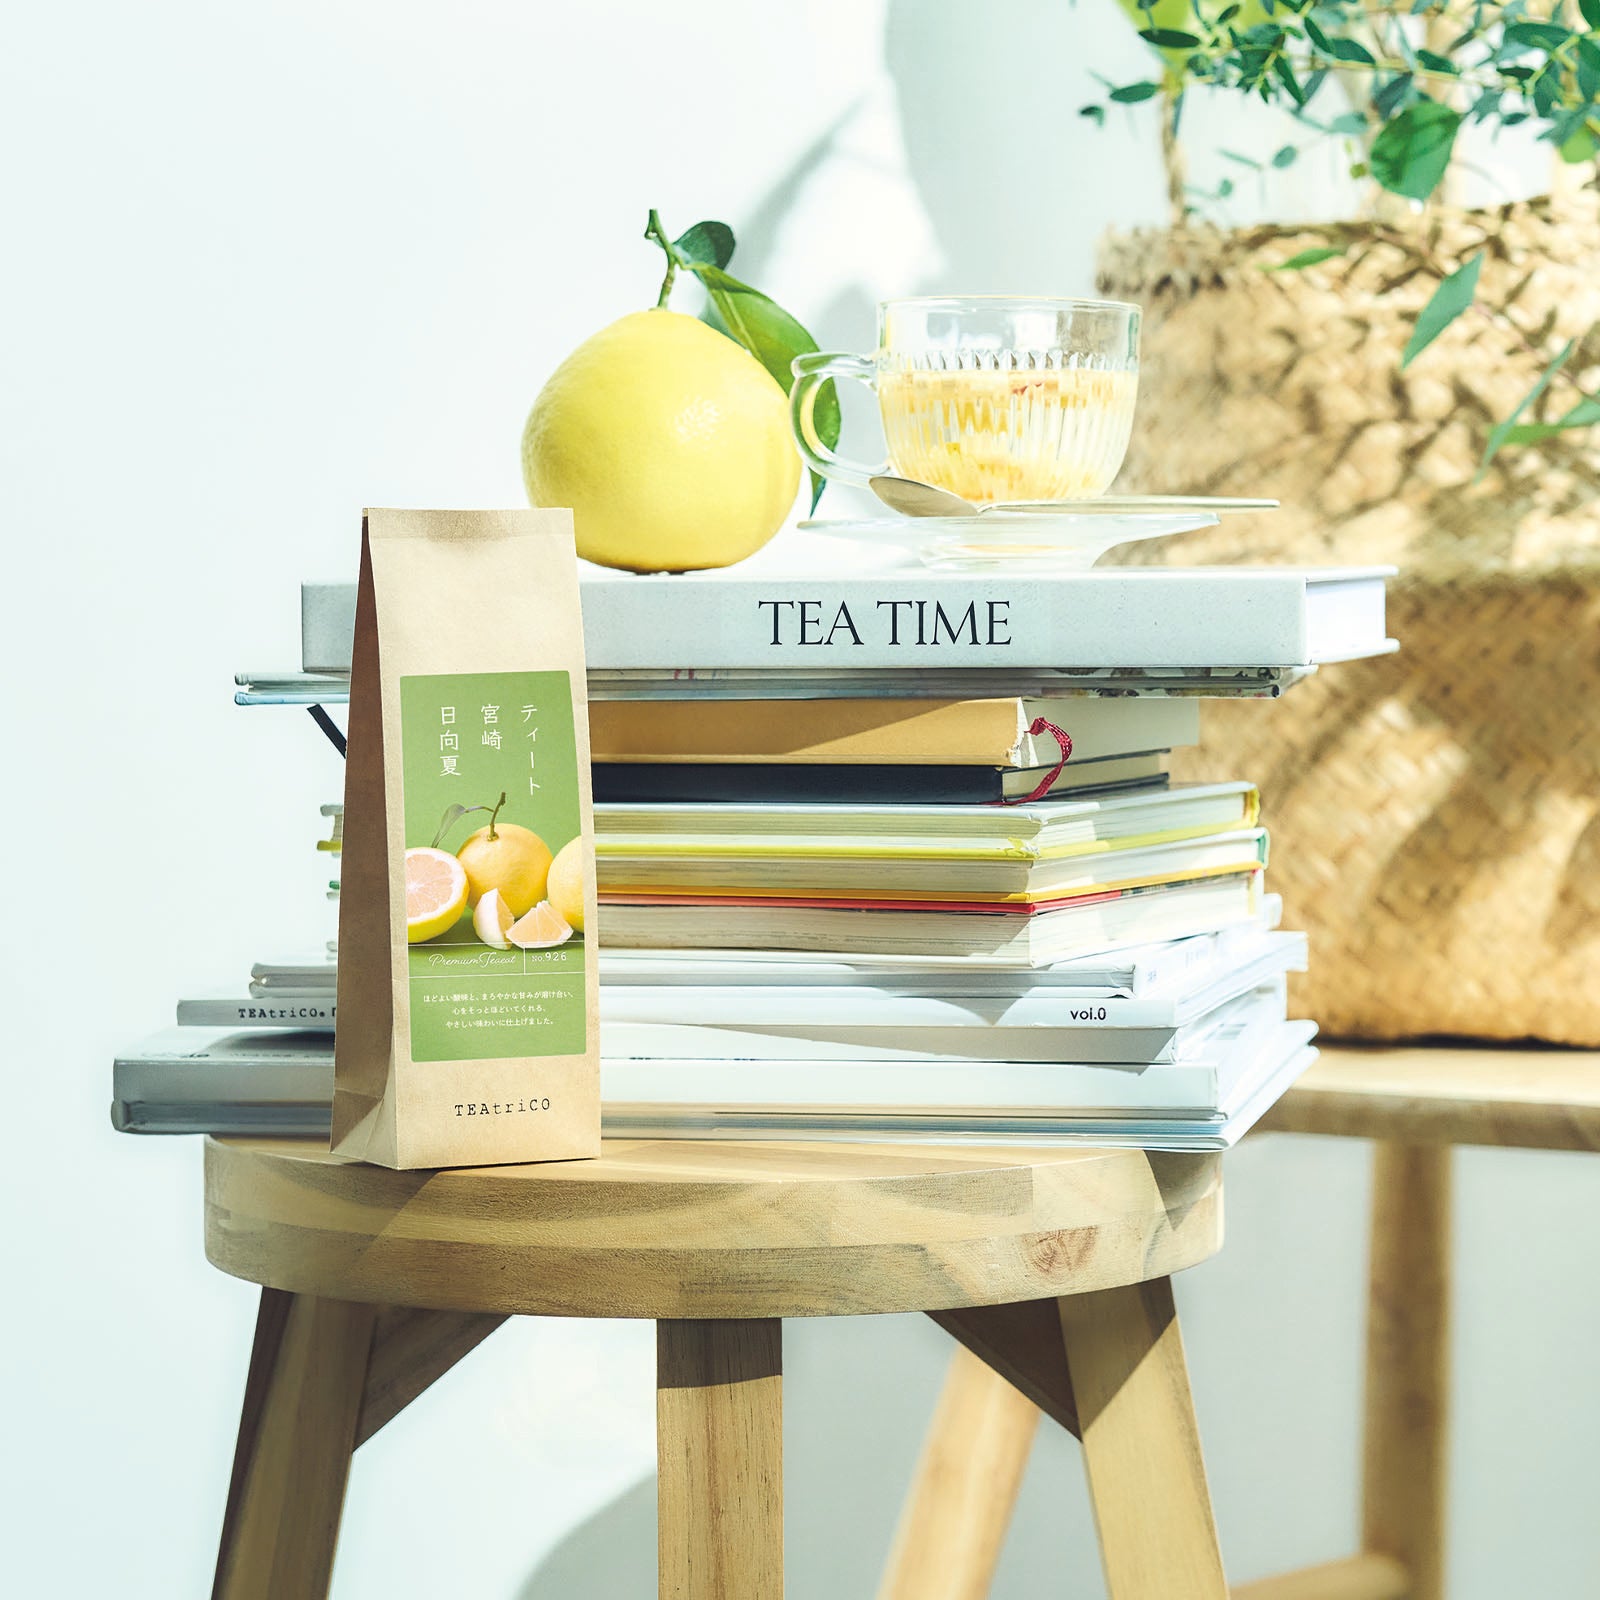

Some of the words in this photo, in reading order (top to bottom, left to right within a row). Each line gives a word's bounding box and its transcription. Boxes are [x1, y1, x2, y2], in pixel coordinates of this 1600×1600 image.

[758, 601, 865, 646] TEA
[877, 601, 1013, 646] TIME
[439, 706, 462, 777] 日向夏
[480, 703, 503, 751] 宮崎
[520, 704, 542, 796] ティート
[429, 953, 479, 967] Premium
[445, 1017, 554, 1030] やさしい味わいに仕上げました。
[1070, 1007, 1107, 1021] vol.0
[454, 1098, 551, 1117] TEAtriCO
